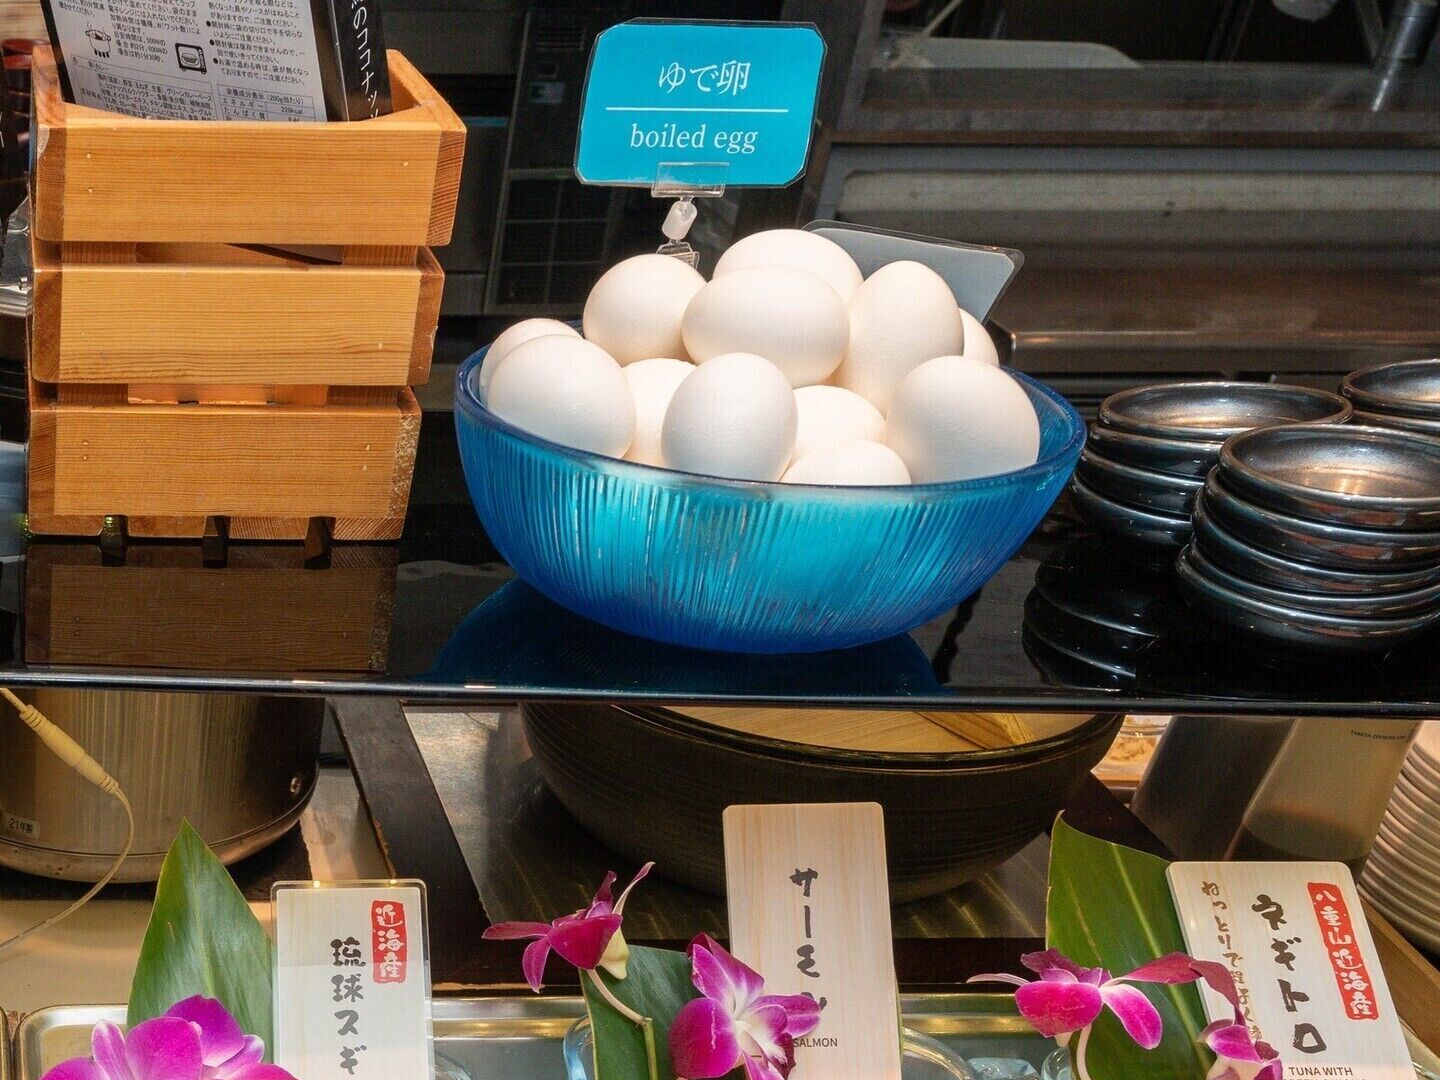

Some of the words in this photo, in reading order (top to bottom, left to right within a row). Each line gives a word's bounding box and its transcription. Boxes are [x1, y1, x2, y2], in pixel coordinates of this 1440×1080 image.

[351, 0, 378, 118] のココナッ
[659, 60, 751, 95] ゆで卵
[630, 122, 706, 148] boiled
[714, 131, 758, 154] egg
[375, 903, 404, 978] 近海産
[1252, 894, 1327, 1054] ネギトロ
[1315, 889, 1373, 1016] 八重山近海産
[330, 936, 367, 1075] 琉球スギ
[793, 1038, 838, 1048] SALMON
[1289, 1067, 1321, 1076] TUNA
[1323, 1067, 1353, 1076] WITH
